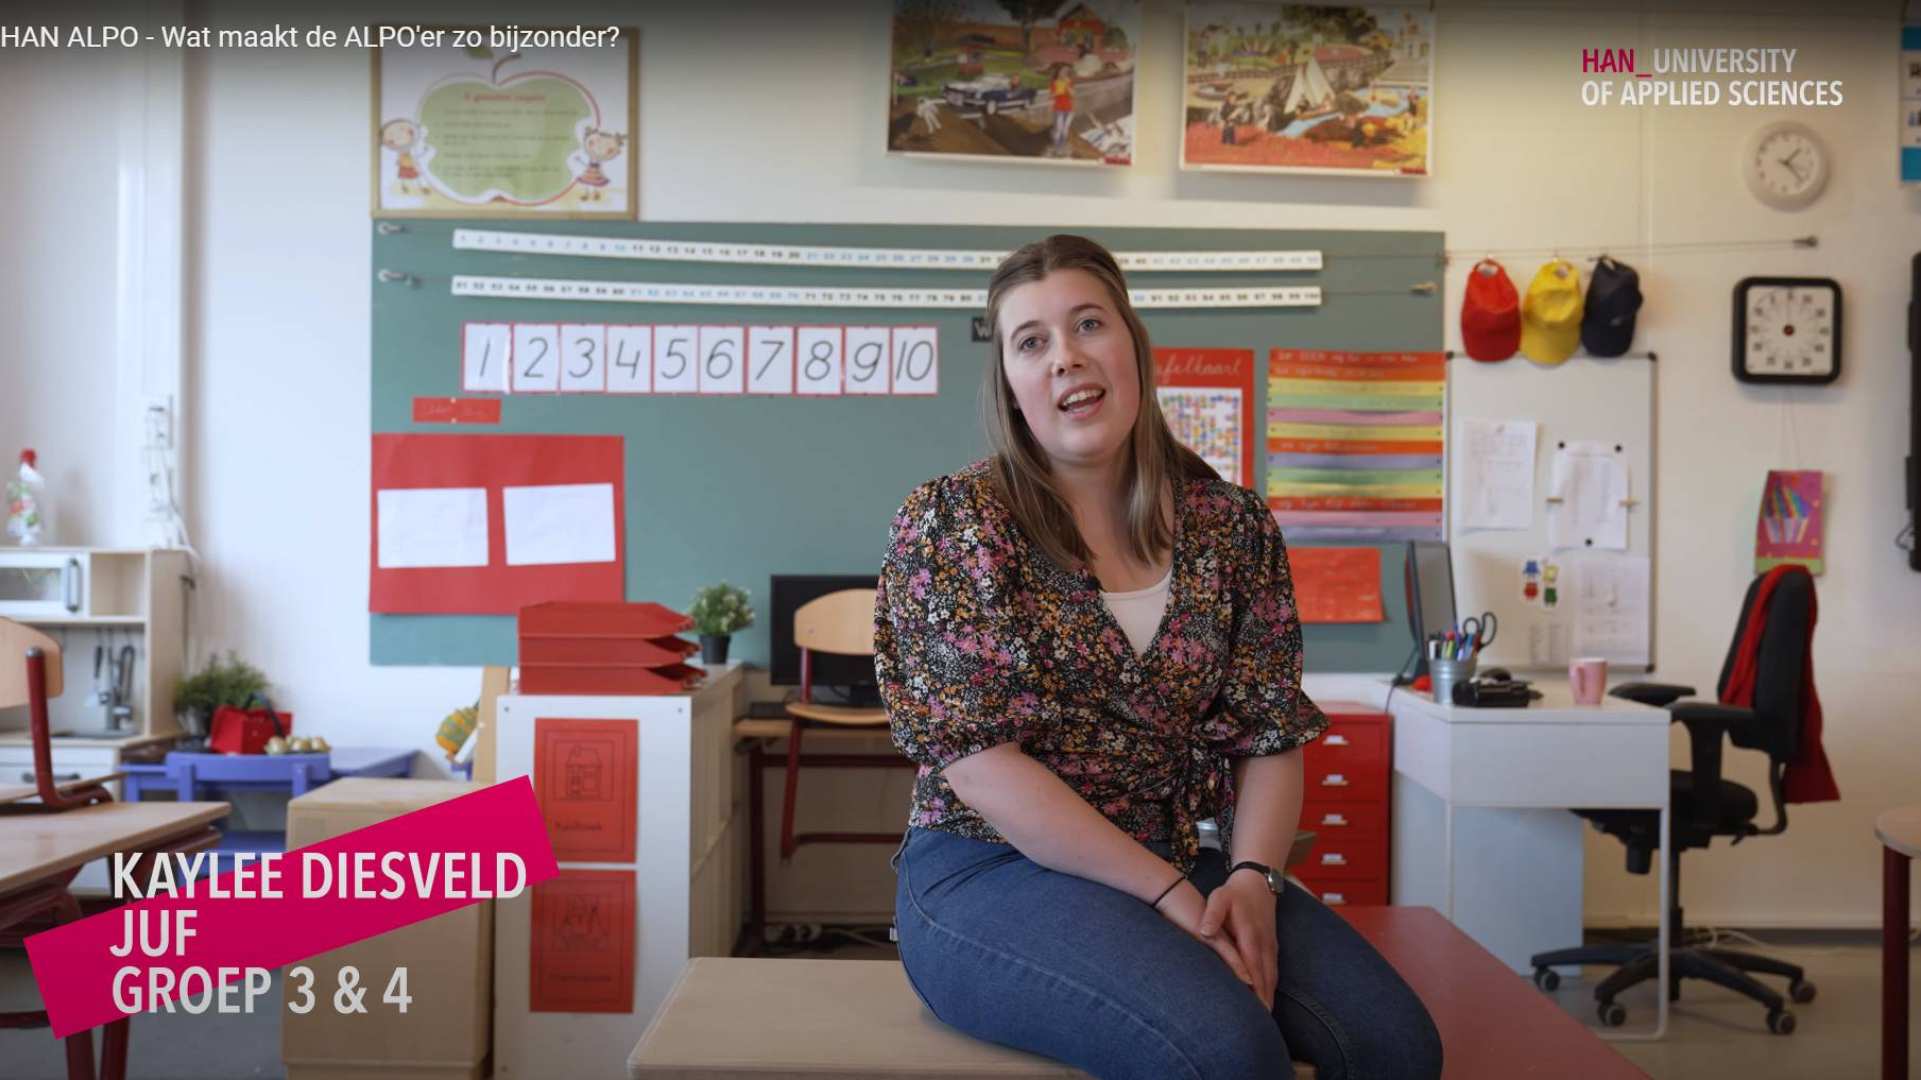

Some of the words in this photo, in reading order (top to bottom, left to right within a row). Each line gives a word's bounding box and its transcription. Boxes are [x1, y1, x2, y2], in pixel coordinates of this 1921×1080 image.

[479, 337, 491, 378] 1
[523, 337, 549, 378] 2
[568, 337, 596, 379] 3
[615, 338, 641, 380] 4
[661, 338, 689, 380] 5
[705, 338, 736, 380] 6
[754, 339, 786, 381] 7
[803, 339, 835, 381] 8
[851, 341, 884, 383] 9
[894, 339, 935, 382] 10
